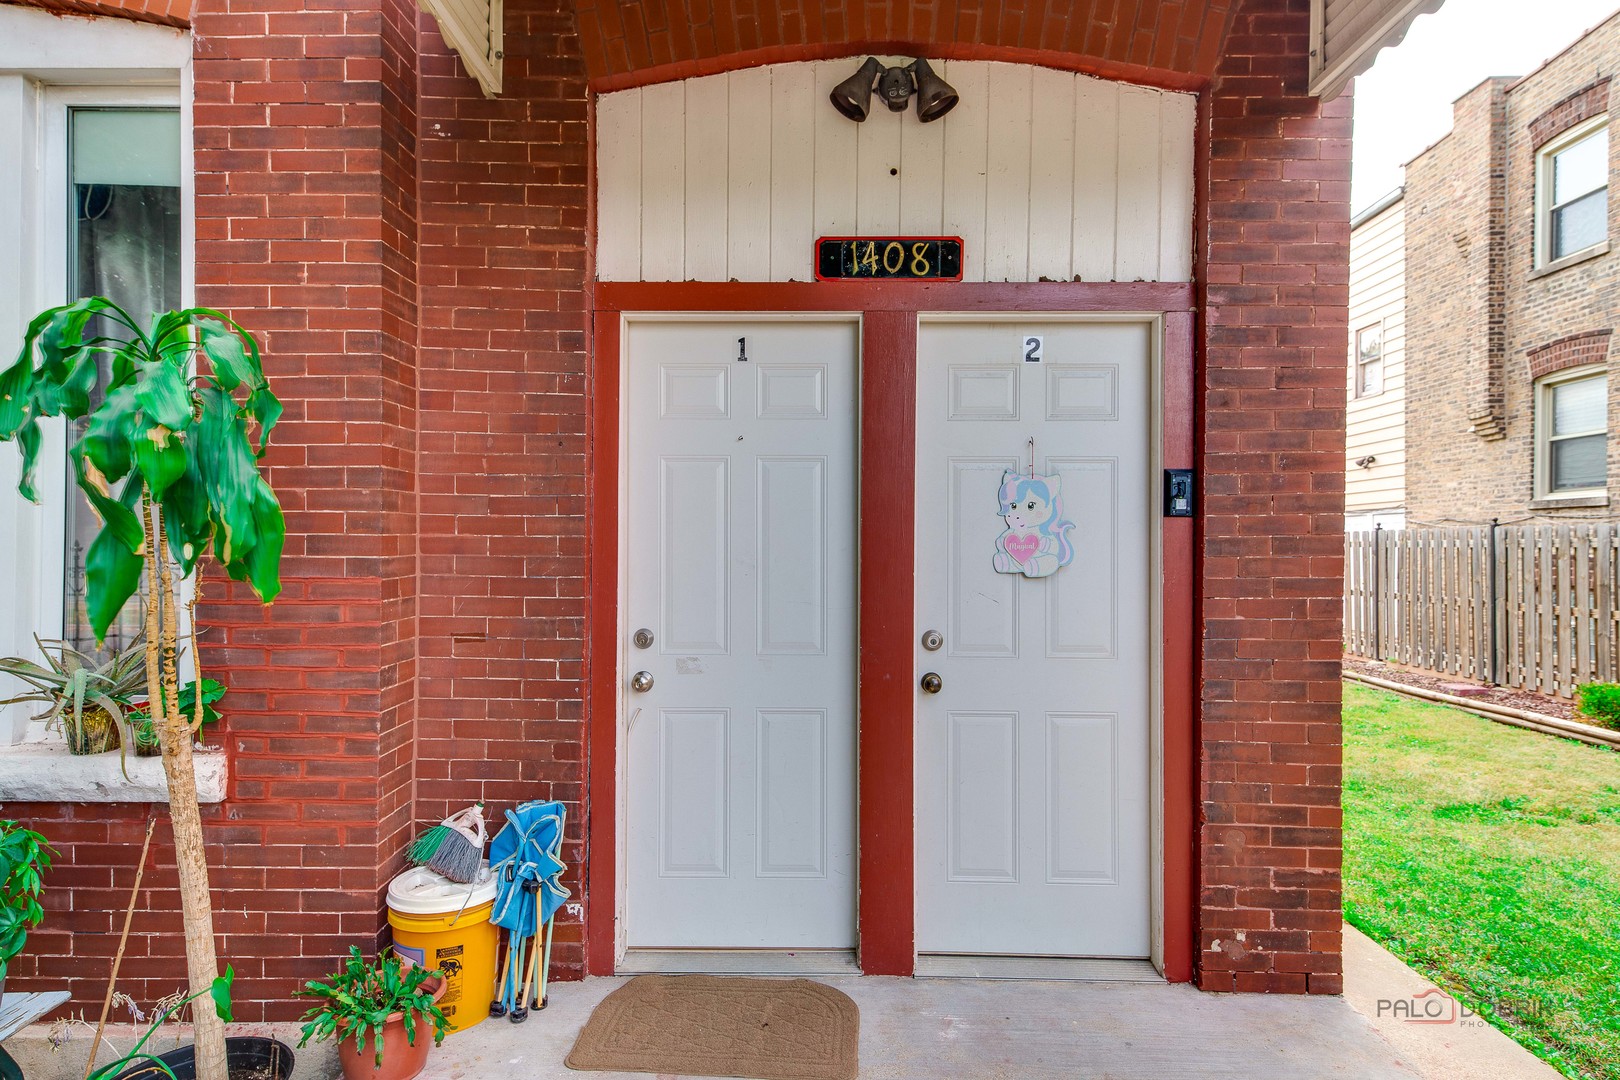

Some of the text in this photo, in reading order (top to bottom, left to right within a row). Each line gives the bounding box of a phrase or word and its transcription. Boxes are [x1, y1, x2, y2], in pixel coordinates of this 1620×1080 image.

[850, 241, 930, 276] 1408
[737, 337, 748, 361] 1
[1025, 337, 1041, 362] 2
